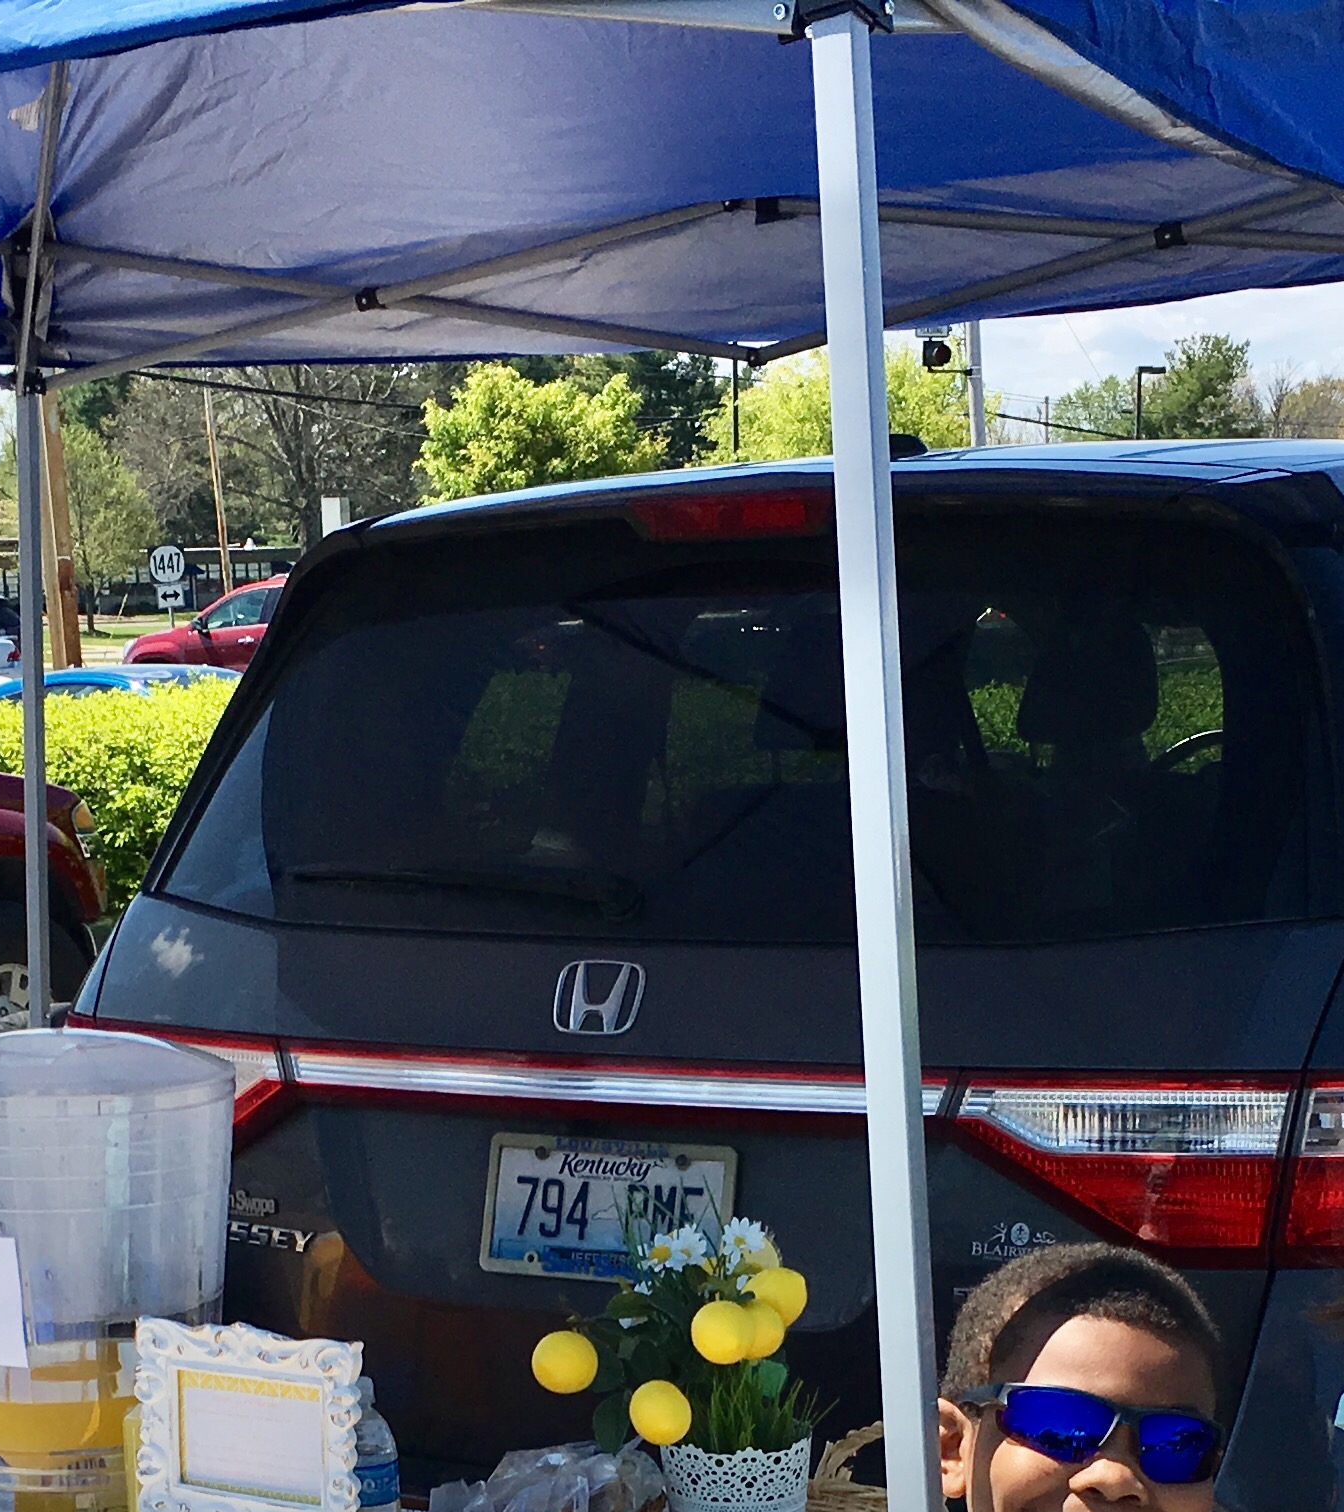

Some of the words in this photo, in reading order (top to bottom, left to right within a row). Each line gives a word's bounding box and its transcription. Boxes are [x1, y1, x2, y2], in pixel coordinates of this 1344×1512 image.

[152, 553, 181, 575] 1447
[559, 1153, 652, 1181] Kentucky
[516, 1176, 589, 1240] 794
